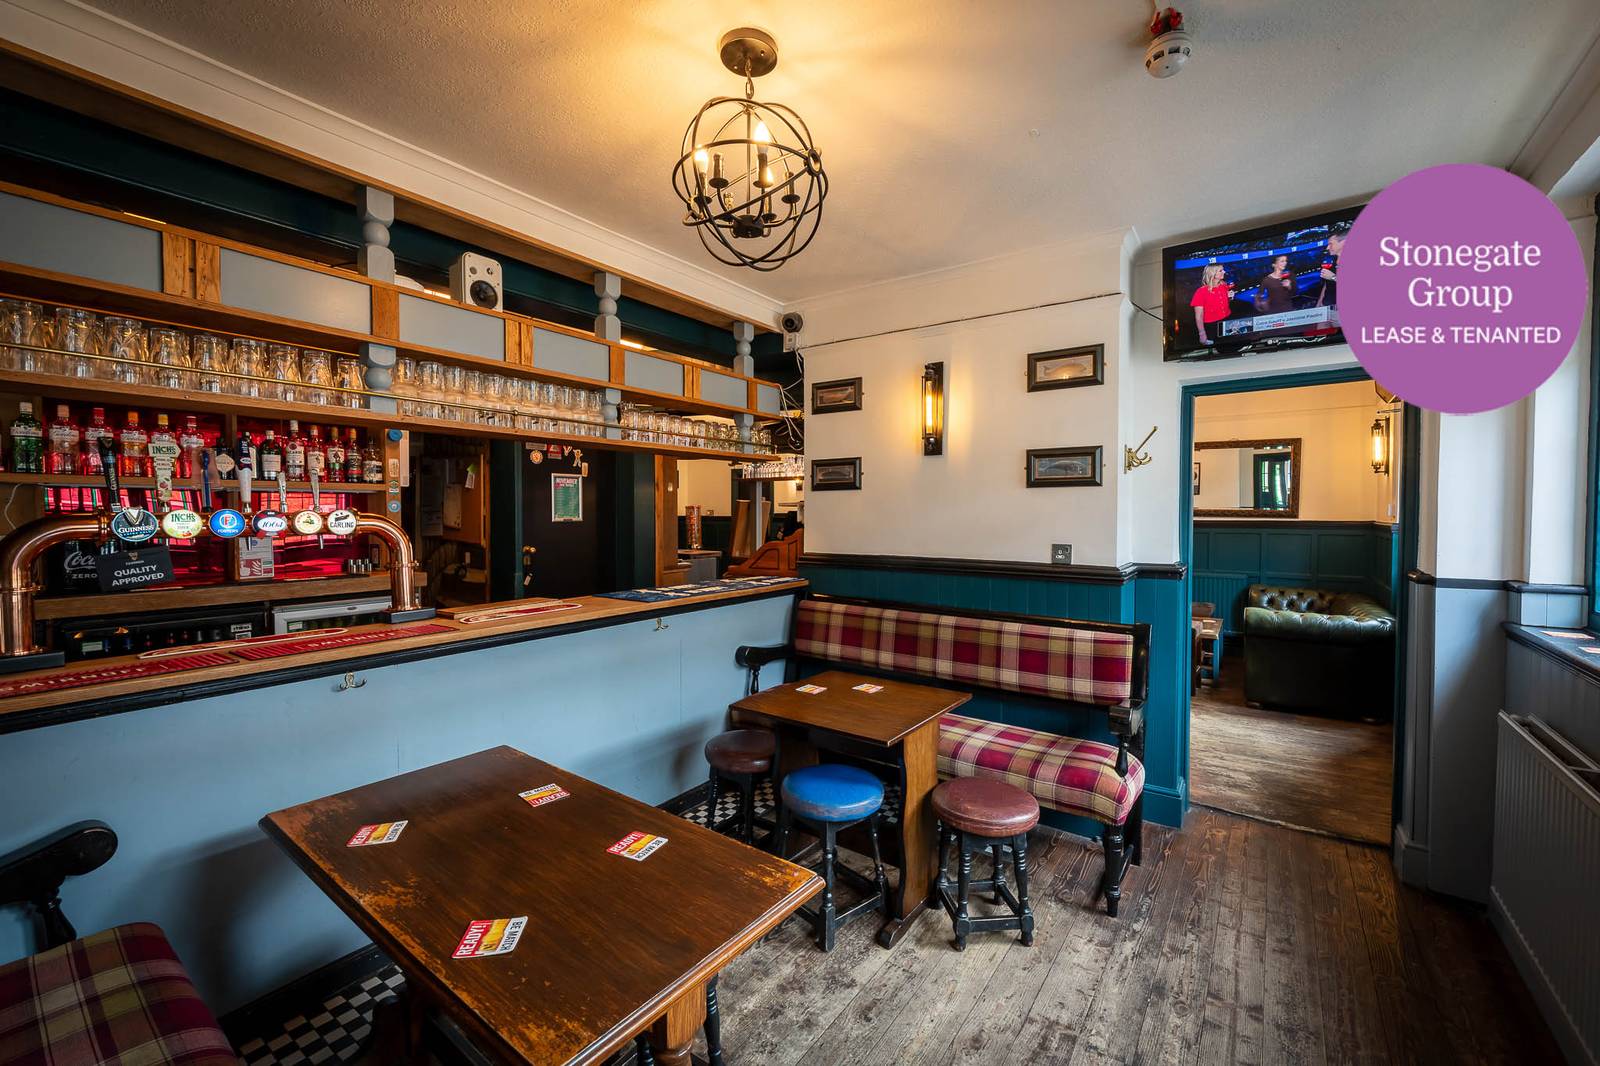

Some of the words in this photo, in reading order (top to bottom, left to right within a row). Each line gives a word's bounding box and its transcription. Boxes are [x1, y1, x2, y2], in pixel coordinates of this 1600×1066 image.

[118, 525, 155, 534] GUINNESS
[330, 521, 355, 529] CARLING
[114, 565, 157, 577] QUALITY
[112, 572, 165, 586] APPROVED
[456, 924, 487, 955] READY!
[500, 931, 519, 951] MATCH
